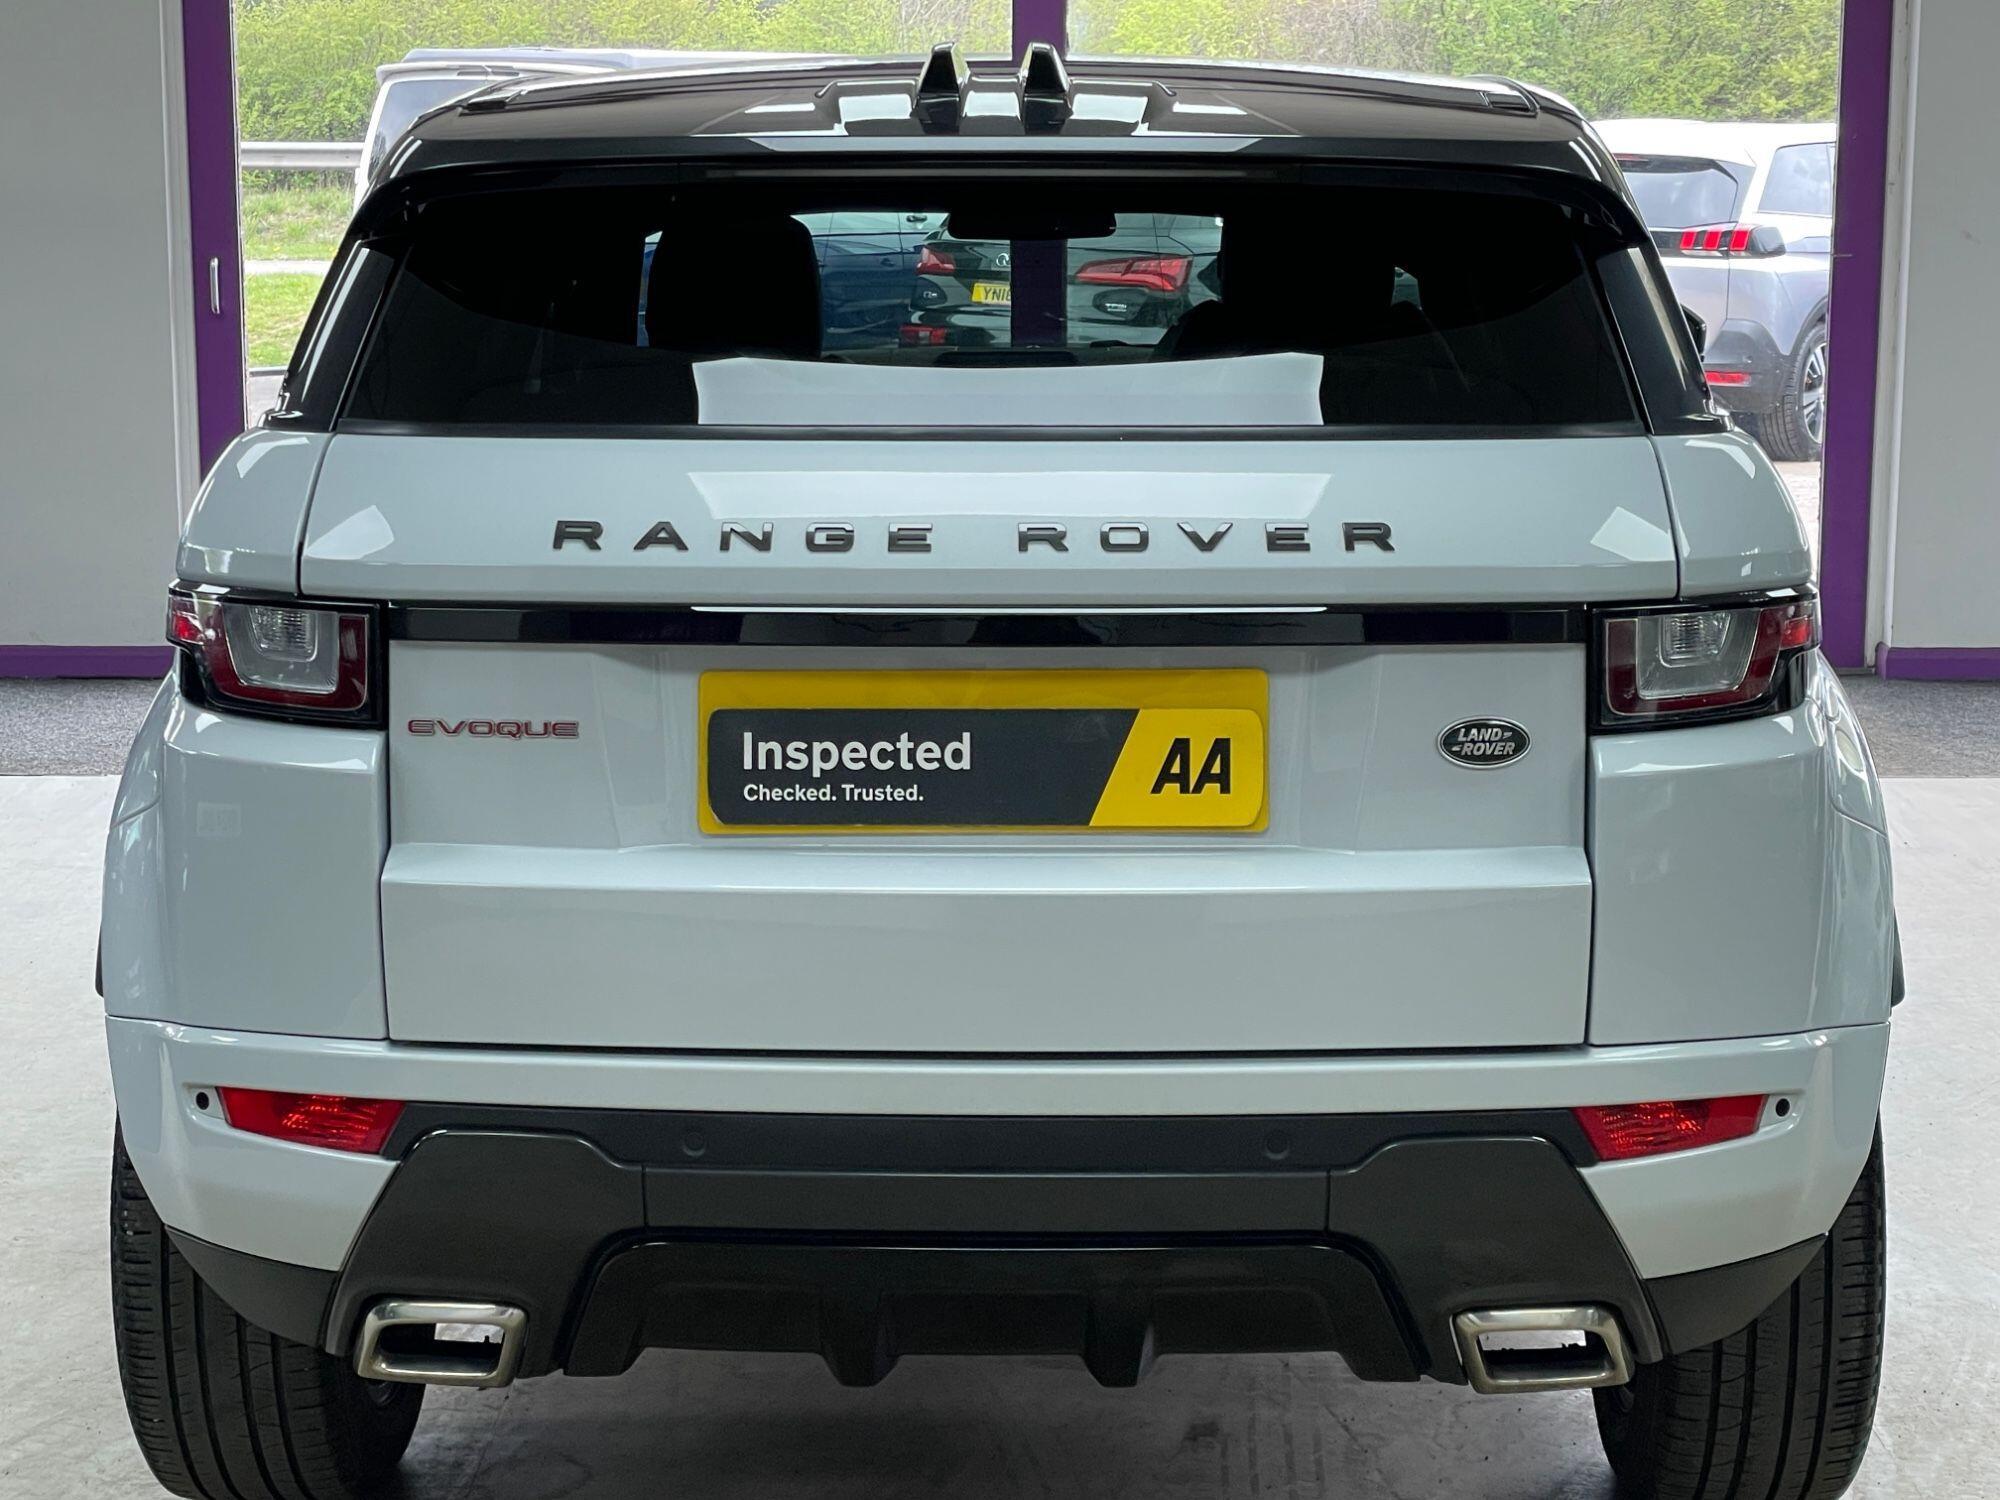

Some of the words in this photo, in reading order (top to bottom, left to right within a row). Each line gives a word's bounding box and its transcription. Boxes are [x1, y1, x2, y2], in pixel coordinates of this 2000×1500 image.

[552, 520, 933, 553] RANGE
[1017, 522, 1396, 553] ROVER
[407, 719, 579, 740] EVOQUE
[1457, 728, 1503, 742] LAND
[742, 731, 972, 777] Inspected
[1460, 742, 1516, 756] ROVER
[1150, 737, 1232, 795] AA
[742, 783, 838, 802] Checked.
[841, 783, 924, 802] Trusted.
